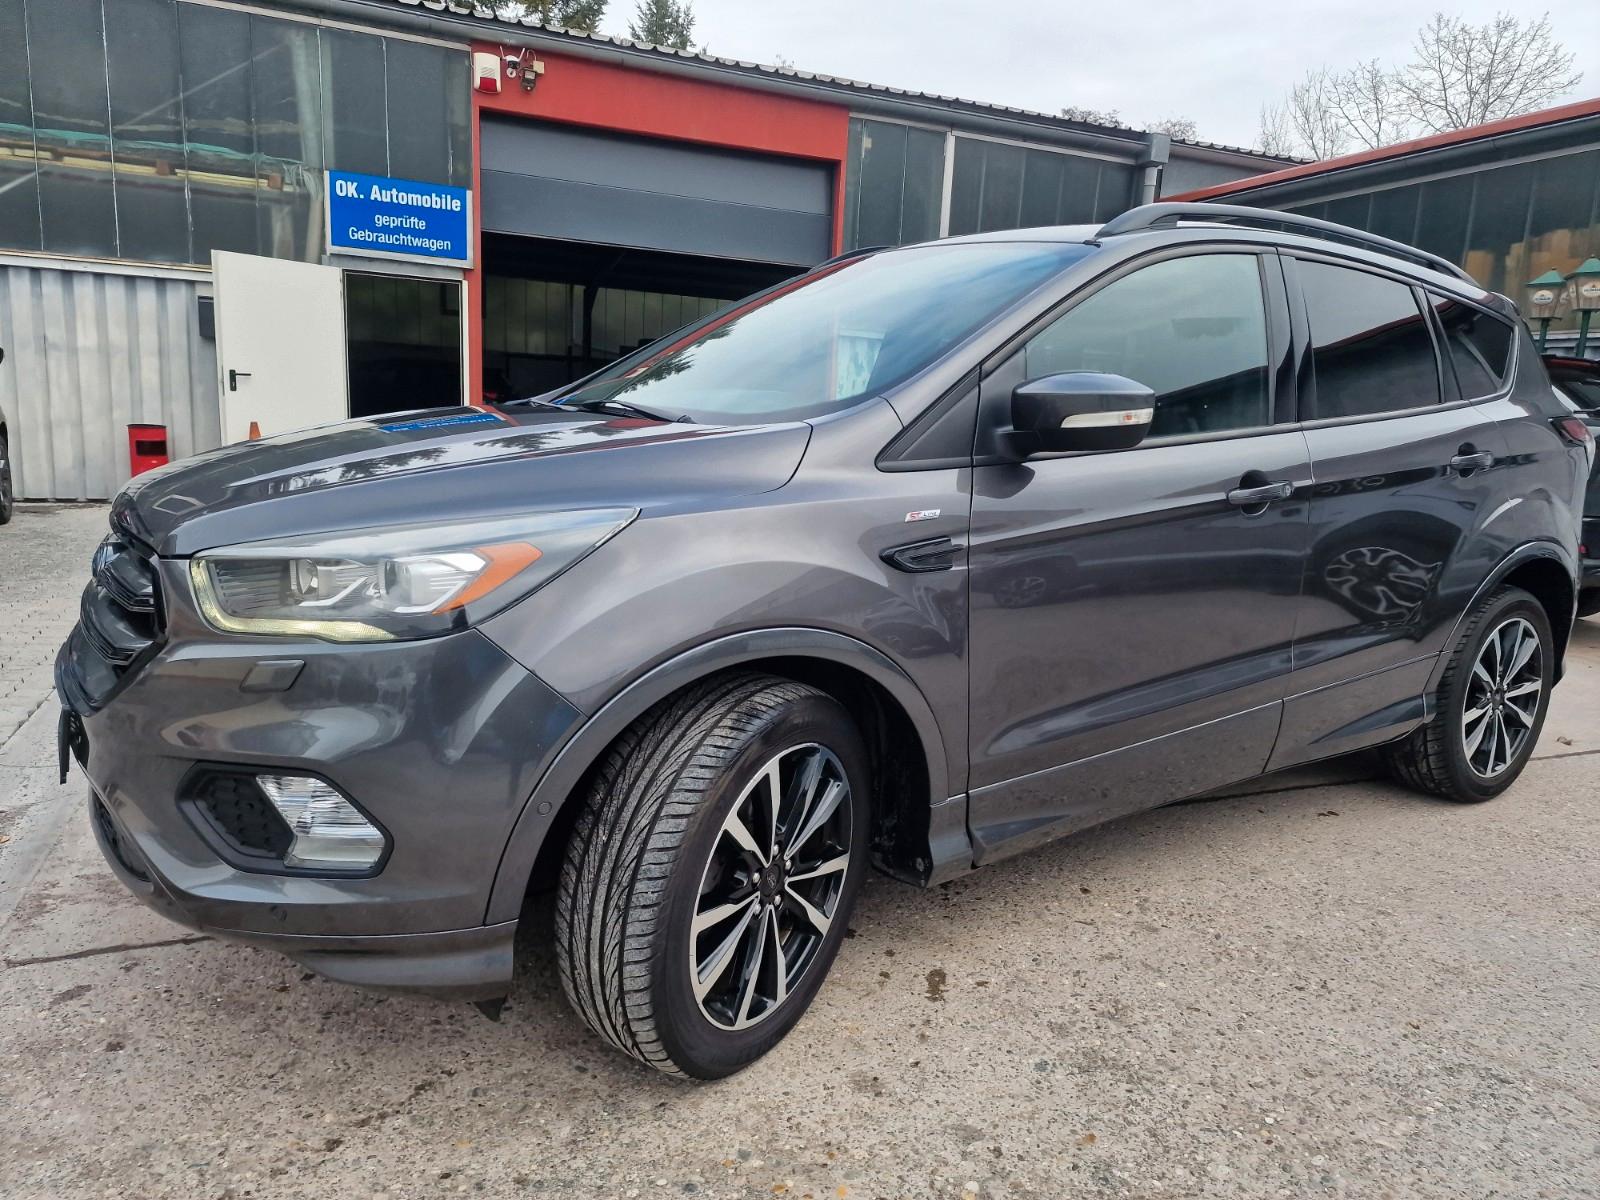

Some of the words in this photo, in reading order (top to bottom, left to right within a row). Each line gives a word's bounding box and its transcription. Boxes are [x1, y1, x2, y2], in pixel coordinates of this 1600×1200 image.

[335, 179, 364, 199] OK.
[370, 185, 461, 211] Automobile
[374, 214, 426, 230] geprüfte
[348, 226, 451, 251] Gebrauchtwagen
